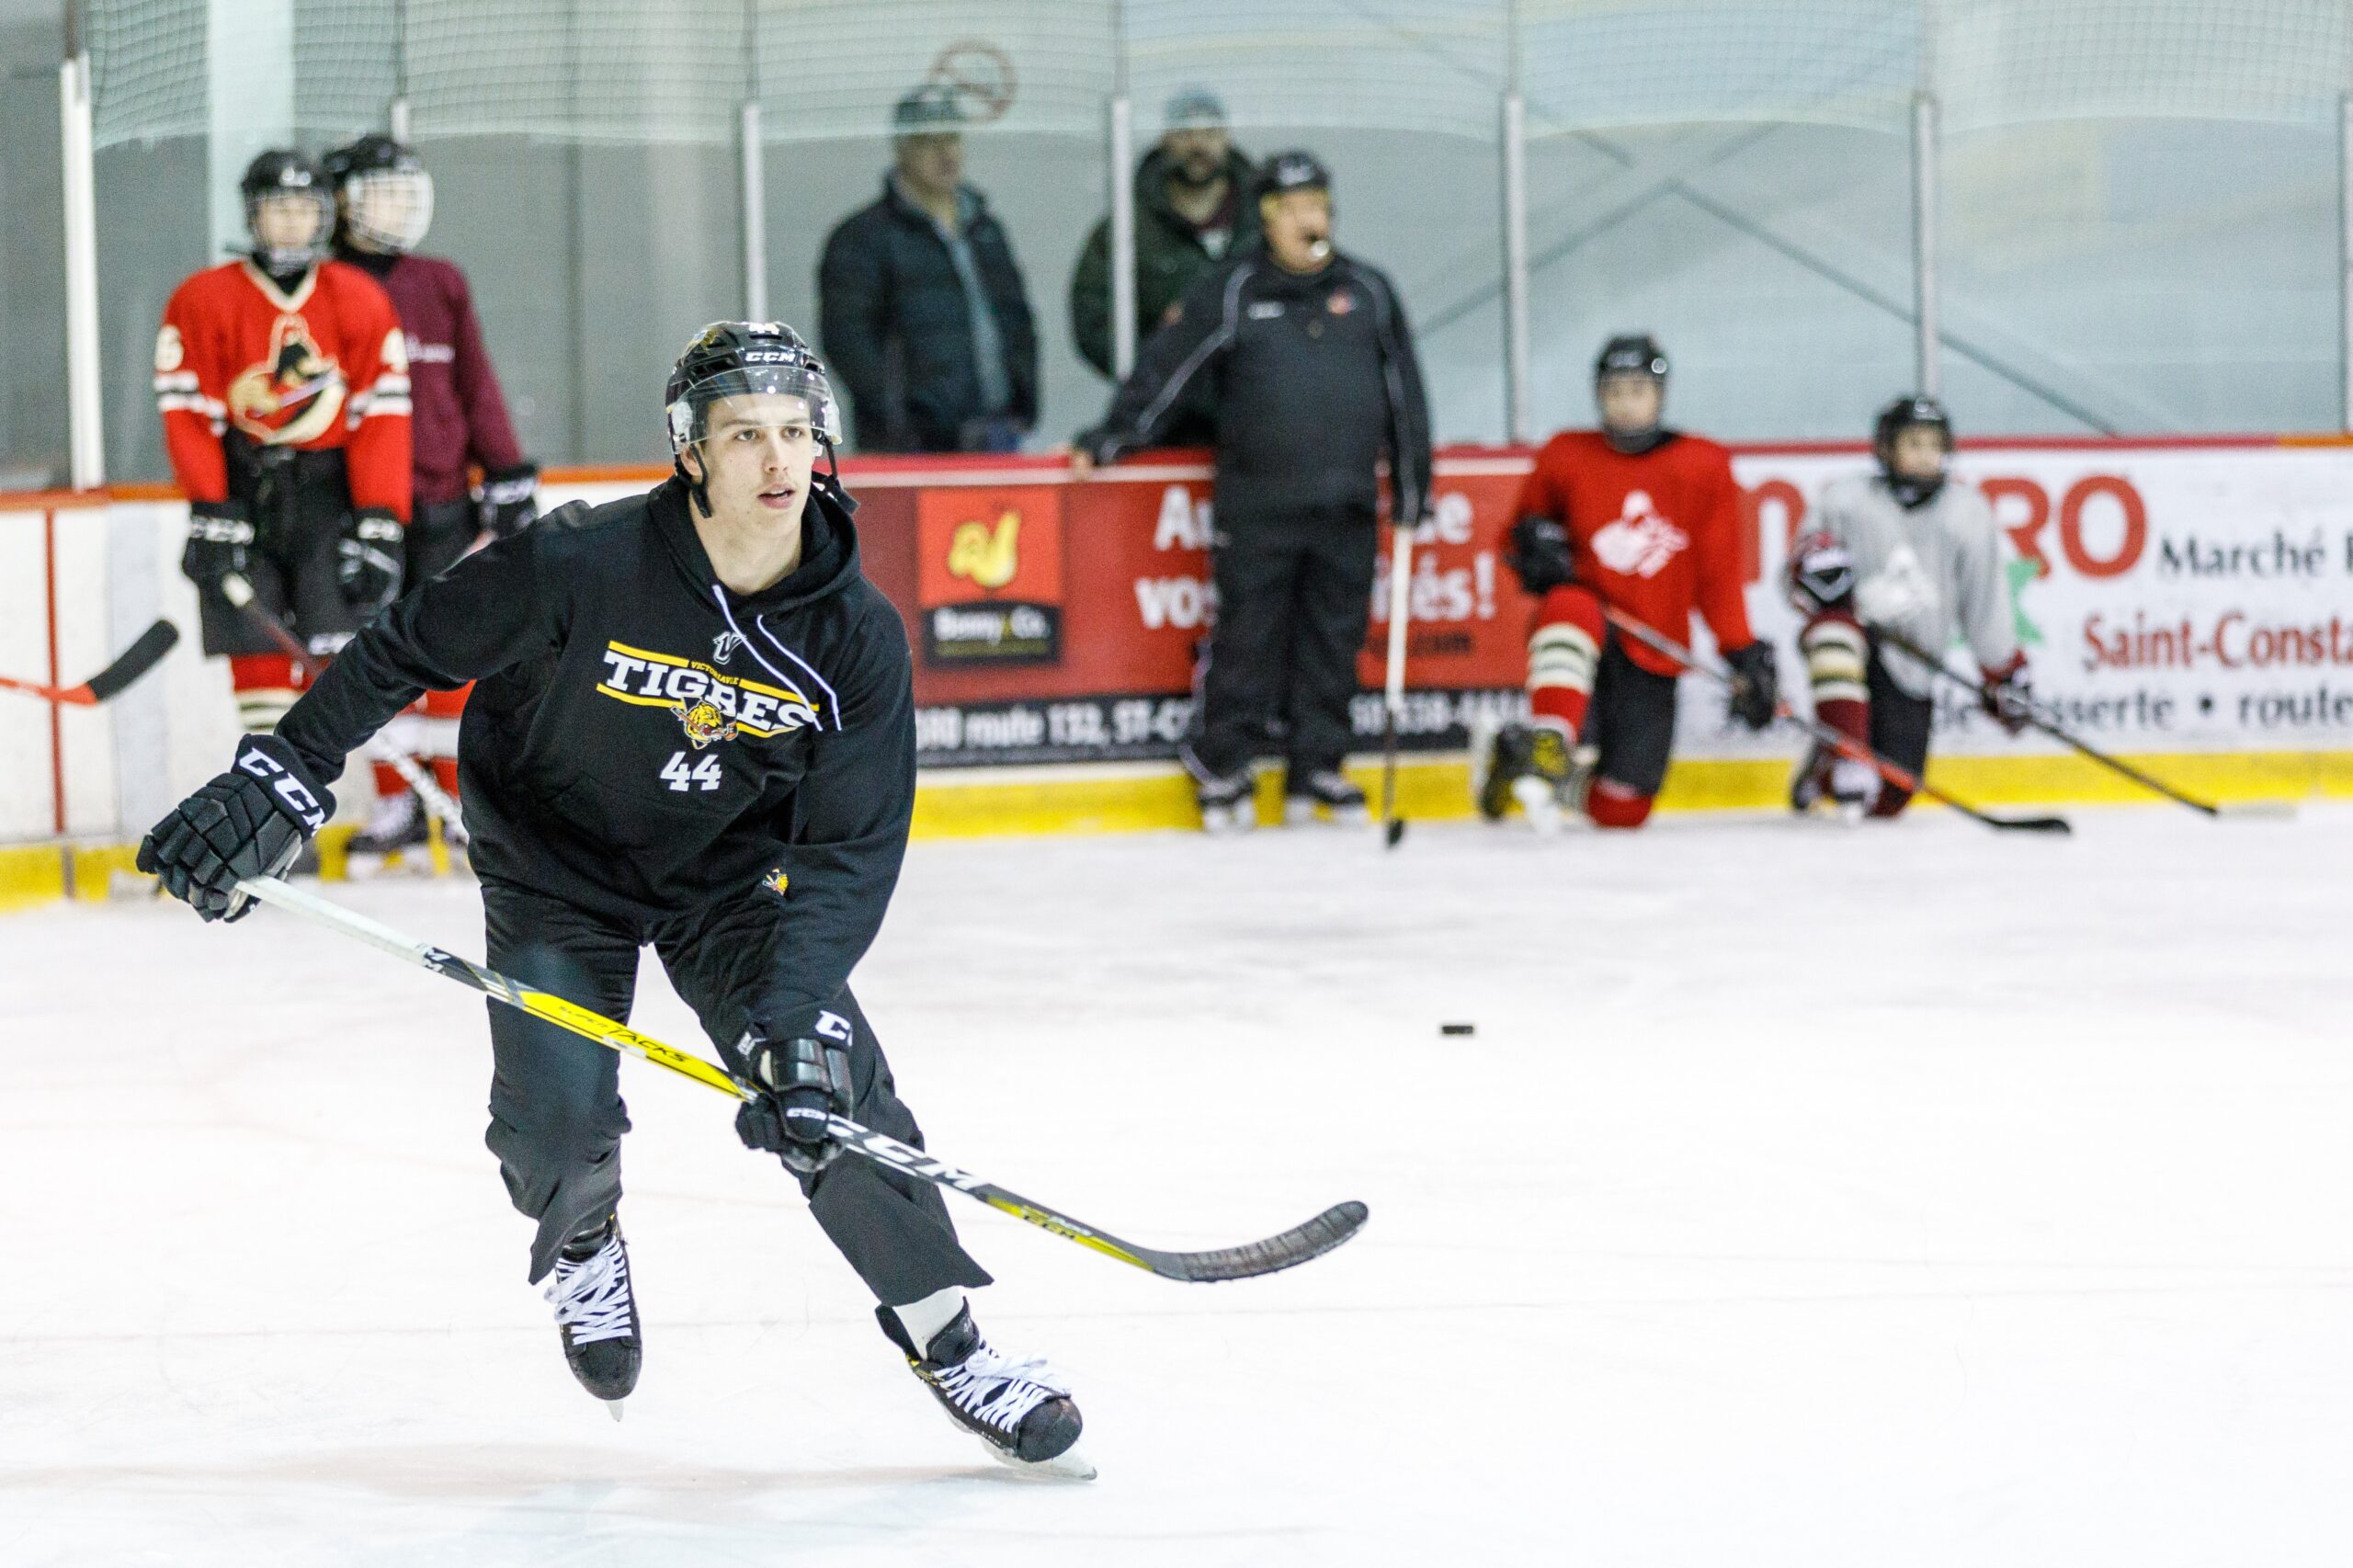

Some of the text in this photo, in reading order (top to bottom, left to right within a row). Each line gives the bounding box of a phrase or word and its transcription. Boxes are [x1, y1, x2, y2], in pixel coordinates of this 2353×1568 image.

[745, 351, 796, 363] CCM
[2160, 528, 2325, 575] Marché
[603, 649, 816, 731] TIGRES
[660, 751, 722, 792] 44
